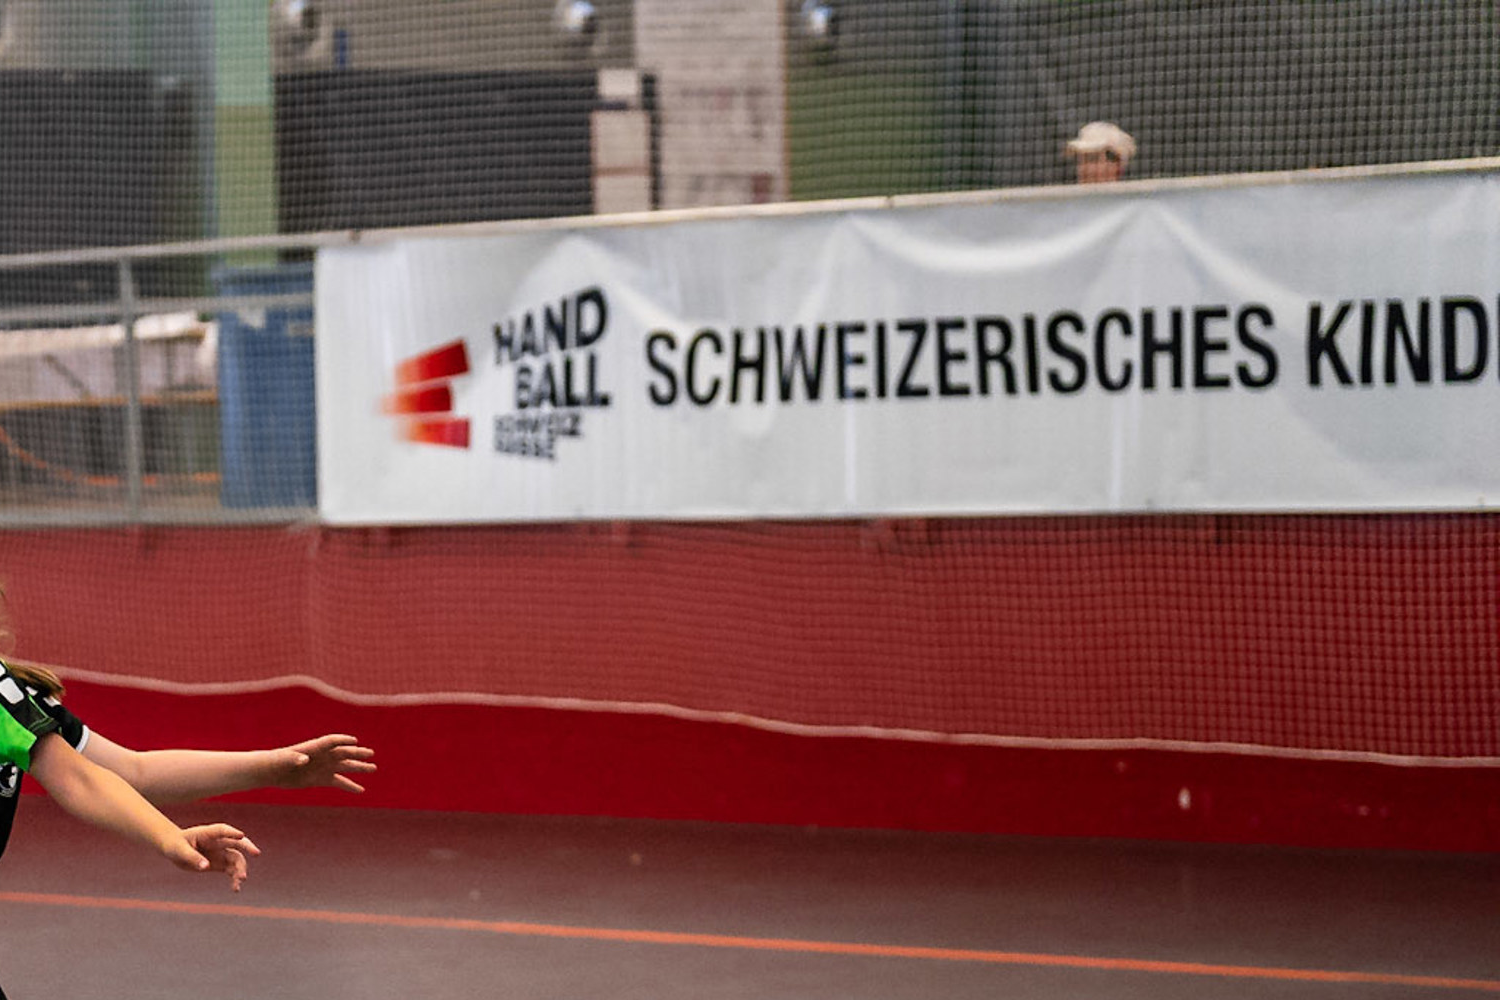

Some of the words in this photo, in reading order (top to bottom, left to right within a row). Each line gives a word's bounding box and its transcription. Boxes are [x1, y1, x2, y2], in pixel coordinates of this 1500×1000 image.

[492, 285, 609, 366] HAND
[645, 303, 1279, 406] SCHWEIZERISCHES
[1307, 293, 1500, 386] KIND
[515, 350, 611, 409] BALL
